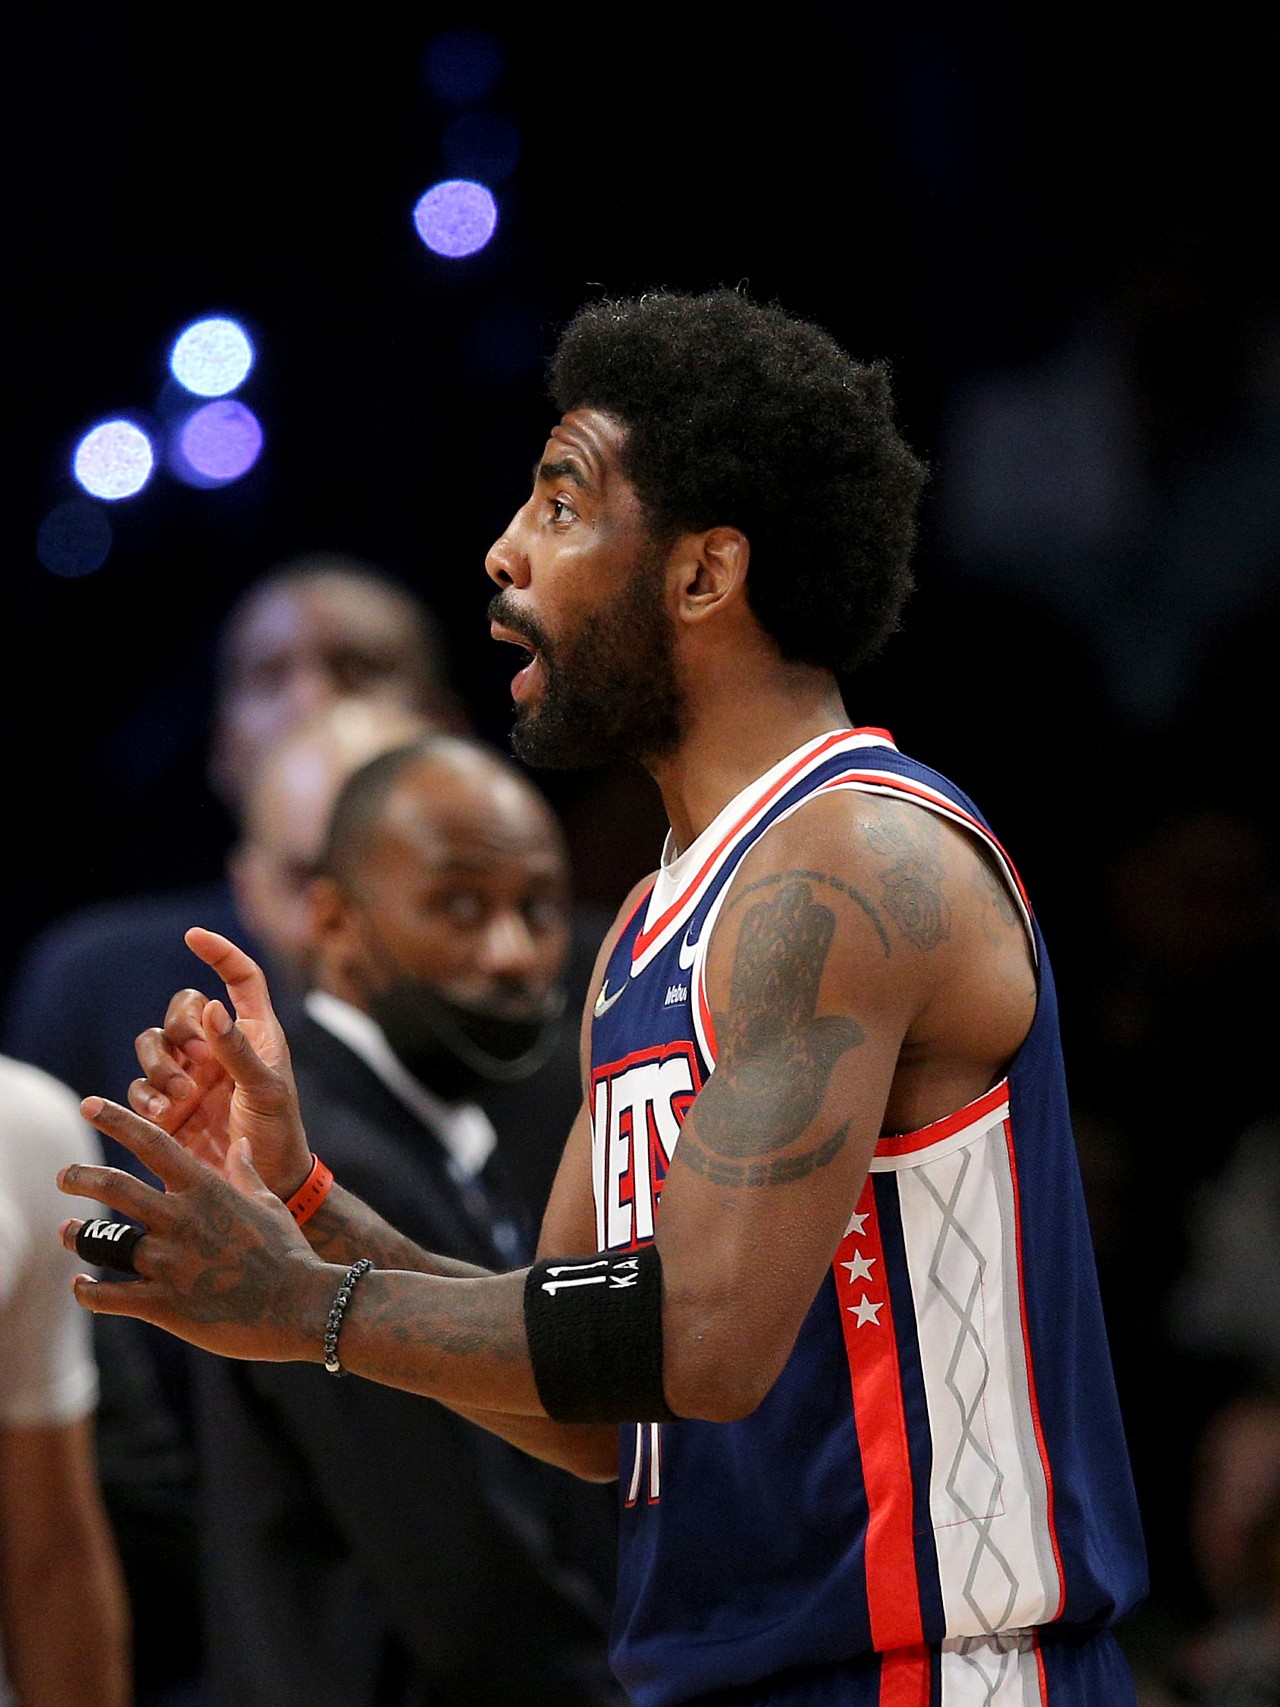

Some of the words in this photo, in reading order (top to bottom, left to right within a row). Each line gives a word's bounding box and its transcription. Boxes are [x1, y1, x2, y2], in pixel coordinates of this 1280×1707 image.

[84, 1219, 131, 1242] KAI
[541, 1260, 609, 1297] 11
[608, 1256, 639, 1289] KA
